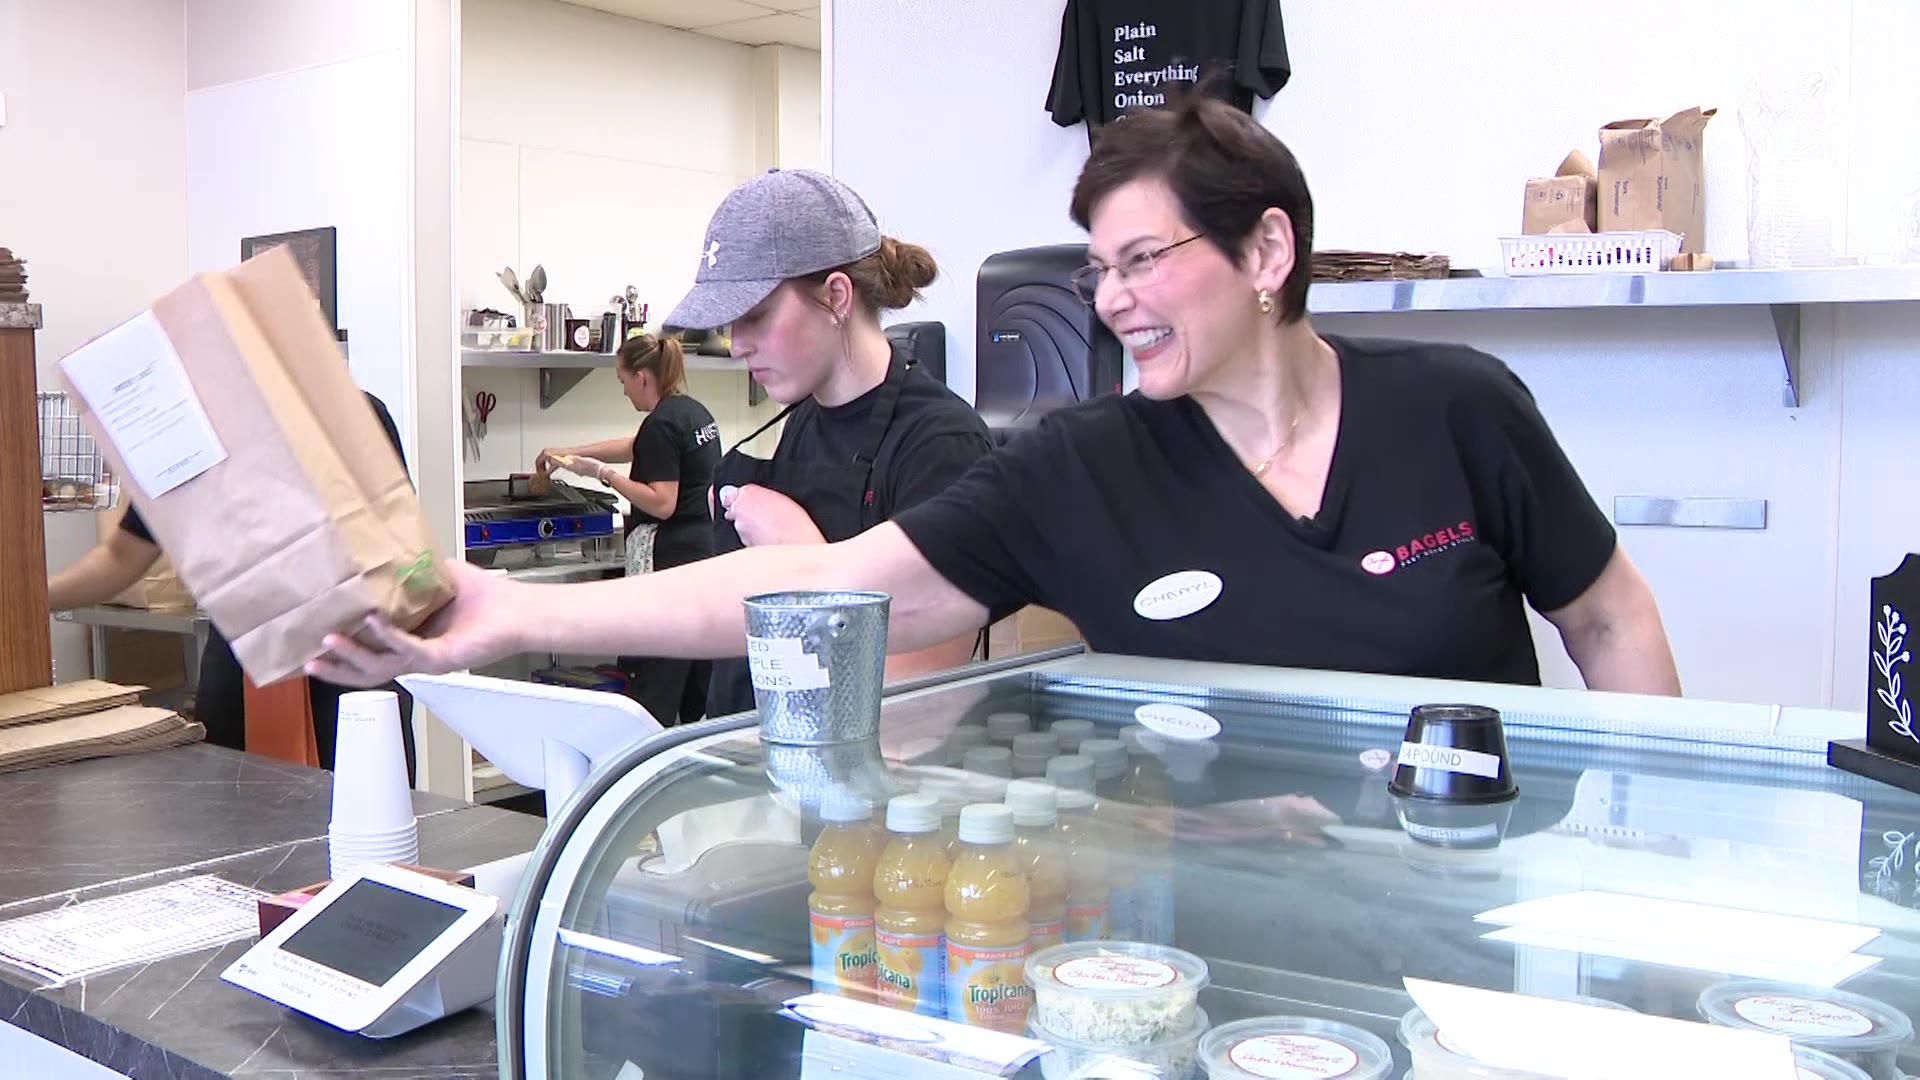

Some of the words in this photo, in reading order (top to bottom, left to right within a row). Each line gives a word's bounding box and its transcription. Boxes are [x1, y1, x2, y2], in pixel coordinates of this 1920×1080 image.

[1114, 22, 1157, 43] Plain
[1114, 46, 1146, 64] Salt
[1114, 64, 1199, 87] Everything
[1114, 89, 1166, 109] Onion
[1396, 521, 1474, 561] BAGELS
[1413, 748, 1462, 767] POUND
